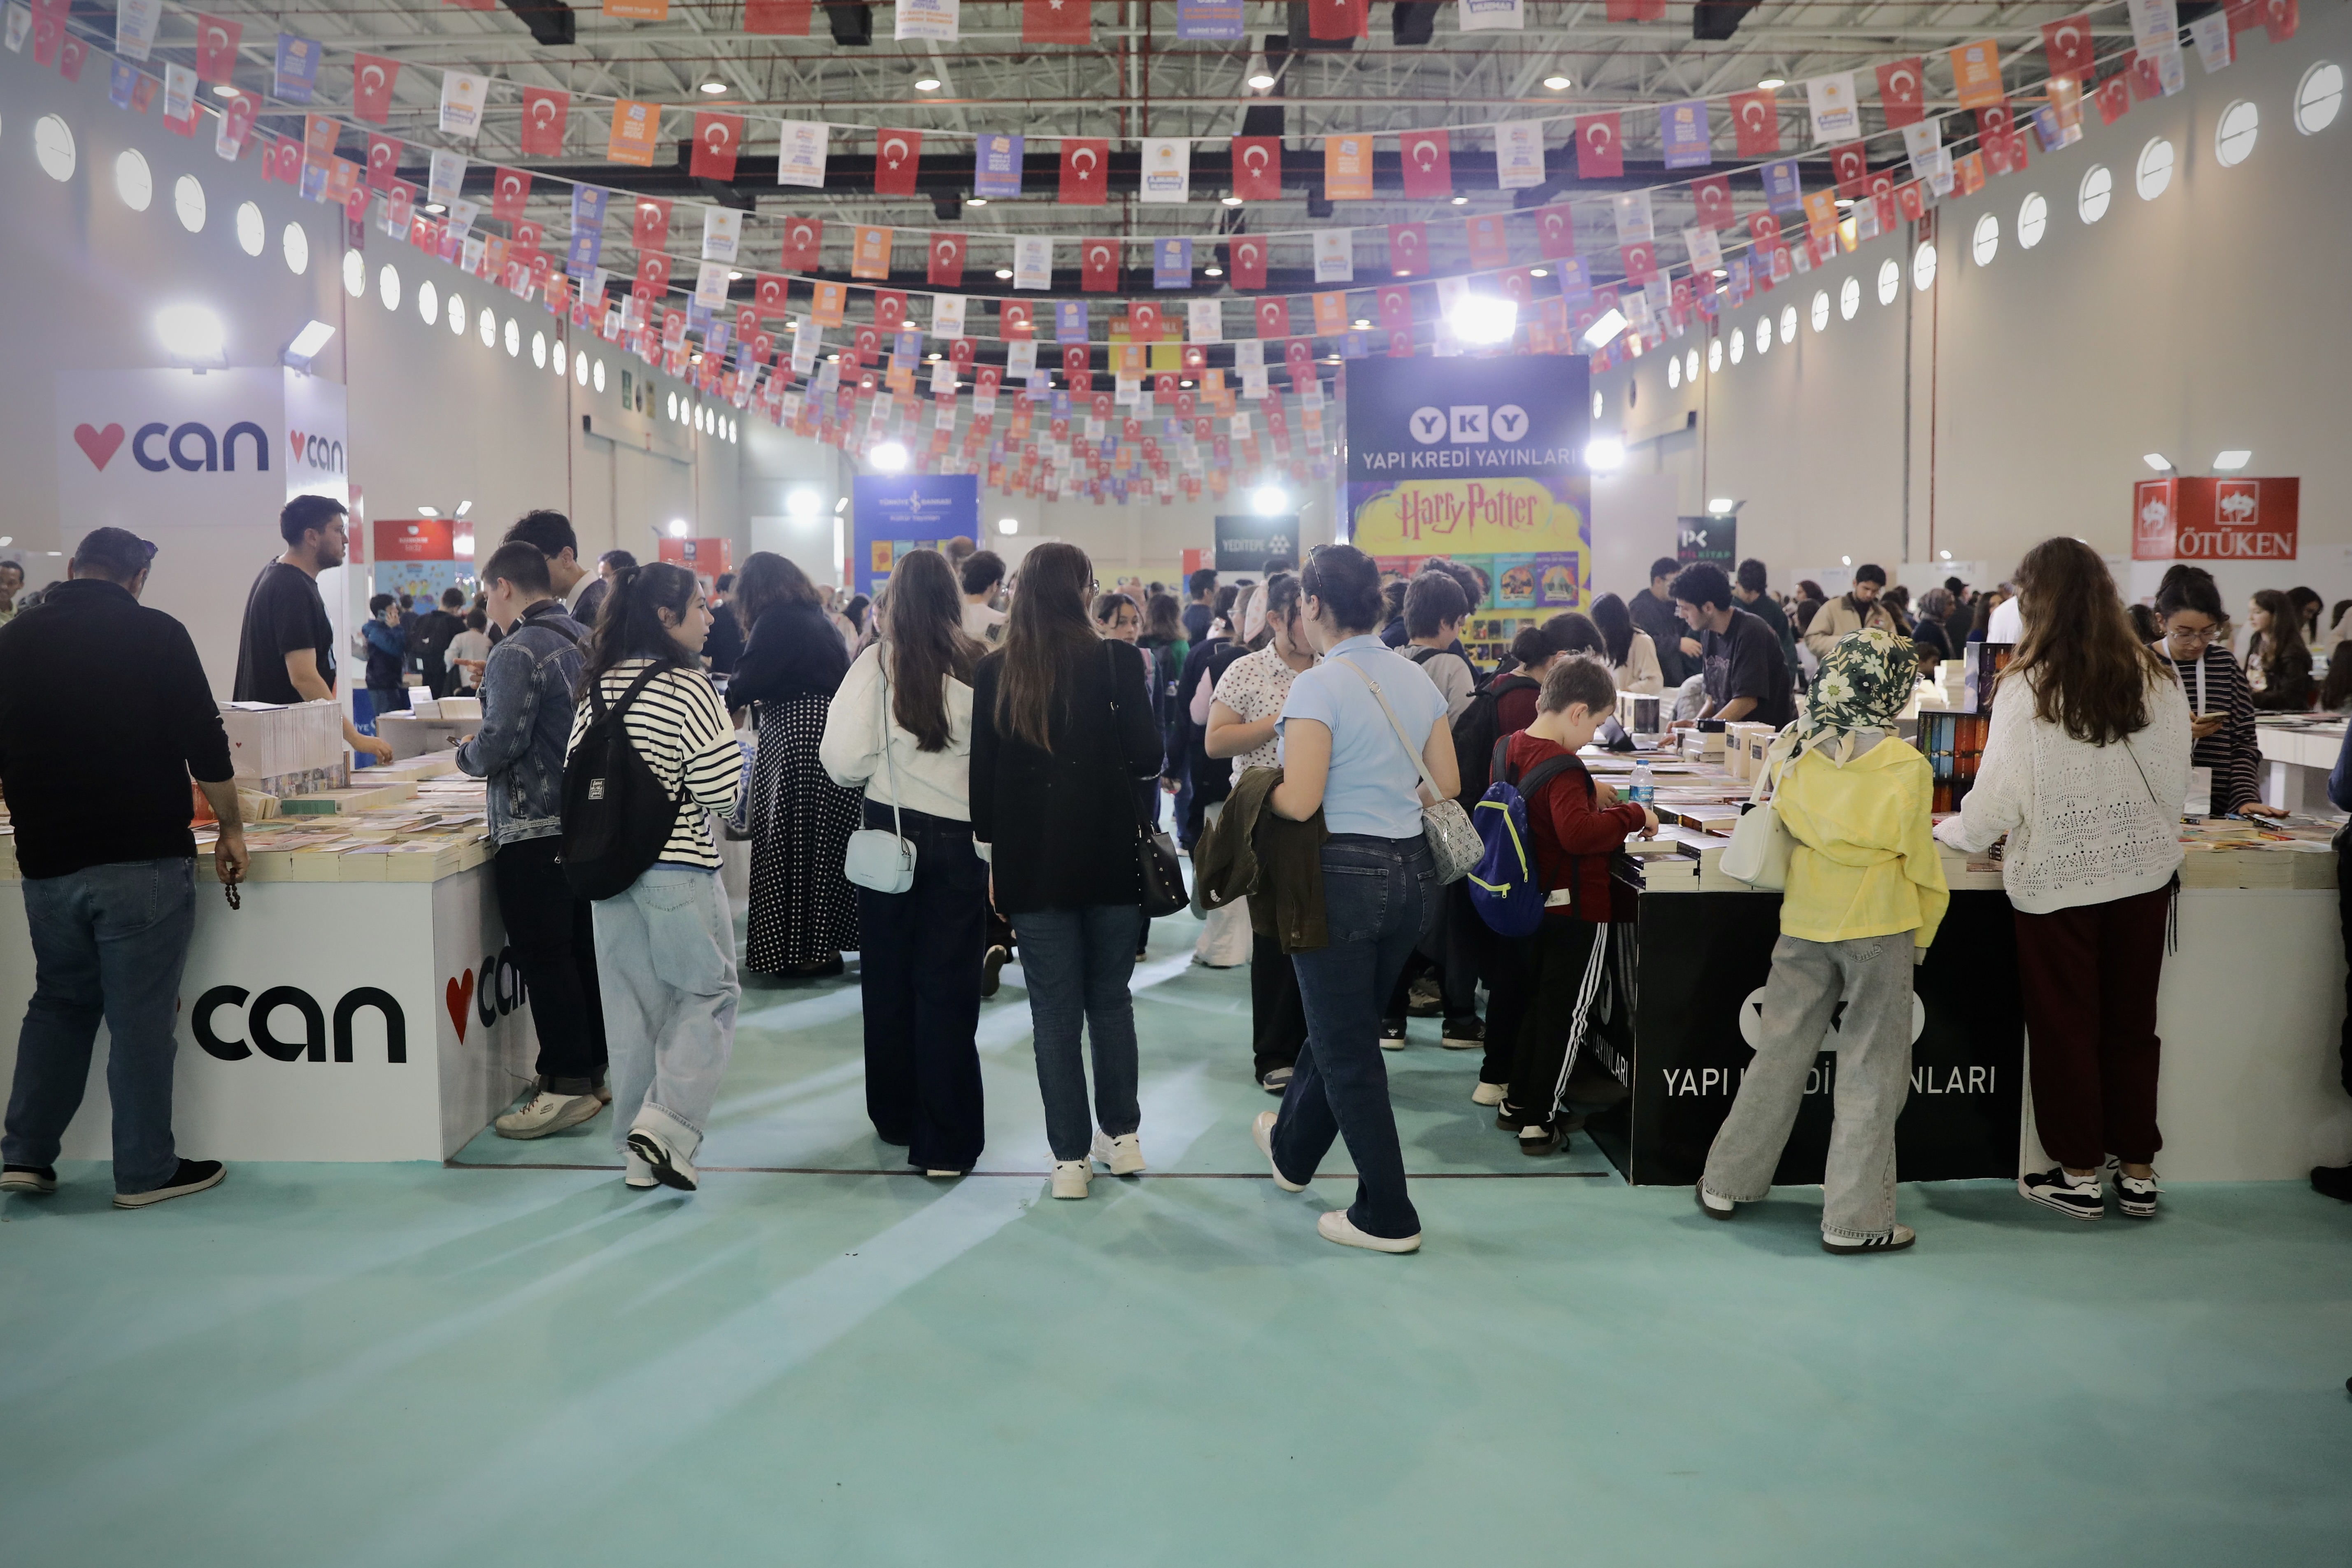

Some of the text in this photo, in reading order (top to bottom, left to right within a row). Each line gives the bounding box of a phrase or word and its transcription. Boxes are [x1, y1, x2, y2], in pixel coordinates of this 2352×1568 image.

[133, 421, 269, 472] can
[307, 433, 344, 474] can
[1363, 447, 1576, 470] YAPI KREDİ YAYINLARI
[1396, 482, 1538, 540] Harry Potter
[2178, 527, 2293, 556] ÖTÜKEN
[191, 984, 407, 1063] can
[1663, 1068, 1728, 1096] YAPI
[1910, 1066, 1994, 1094] NLARI
